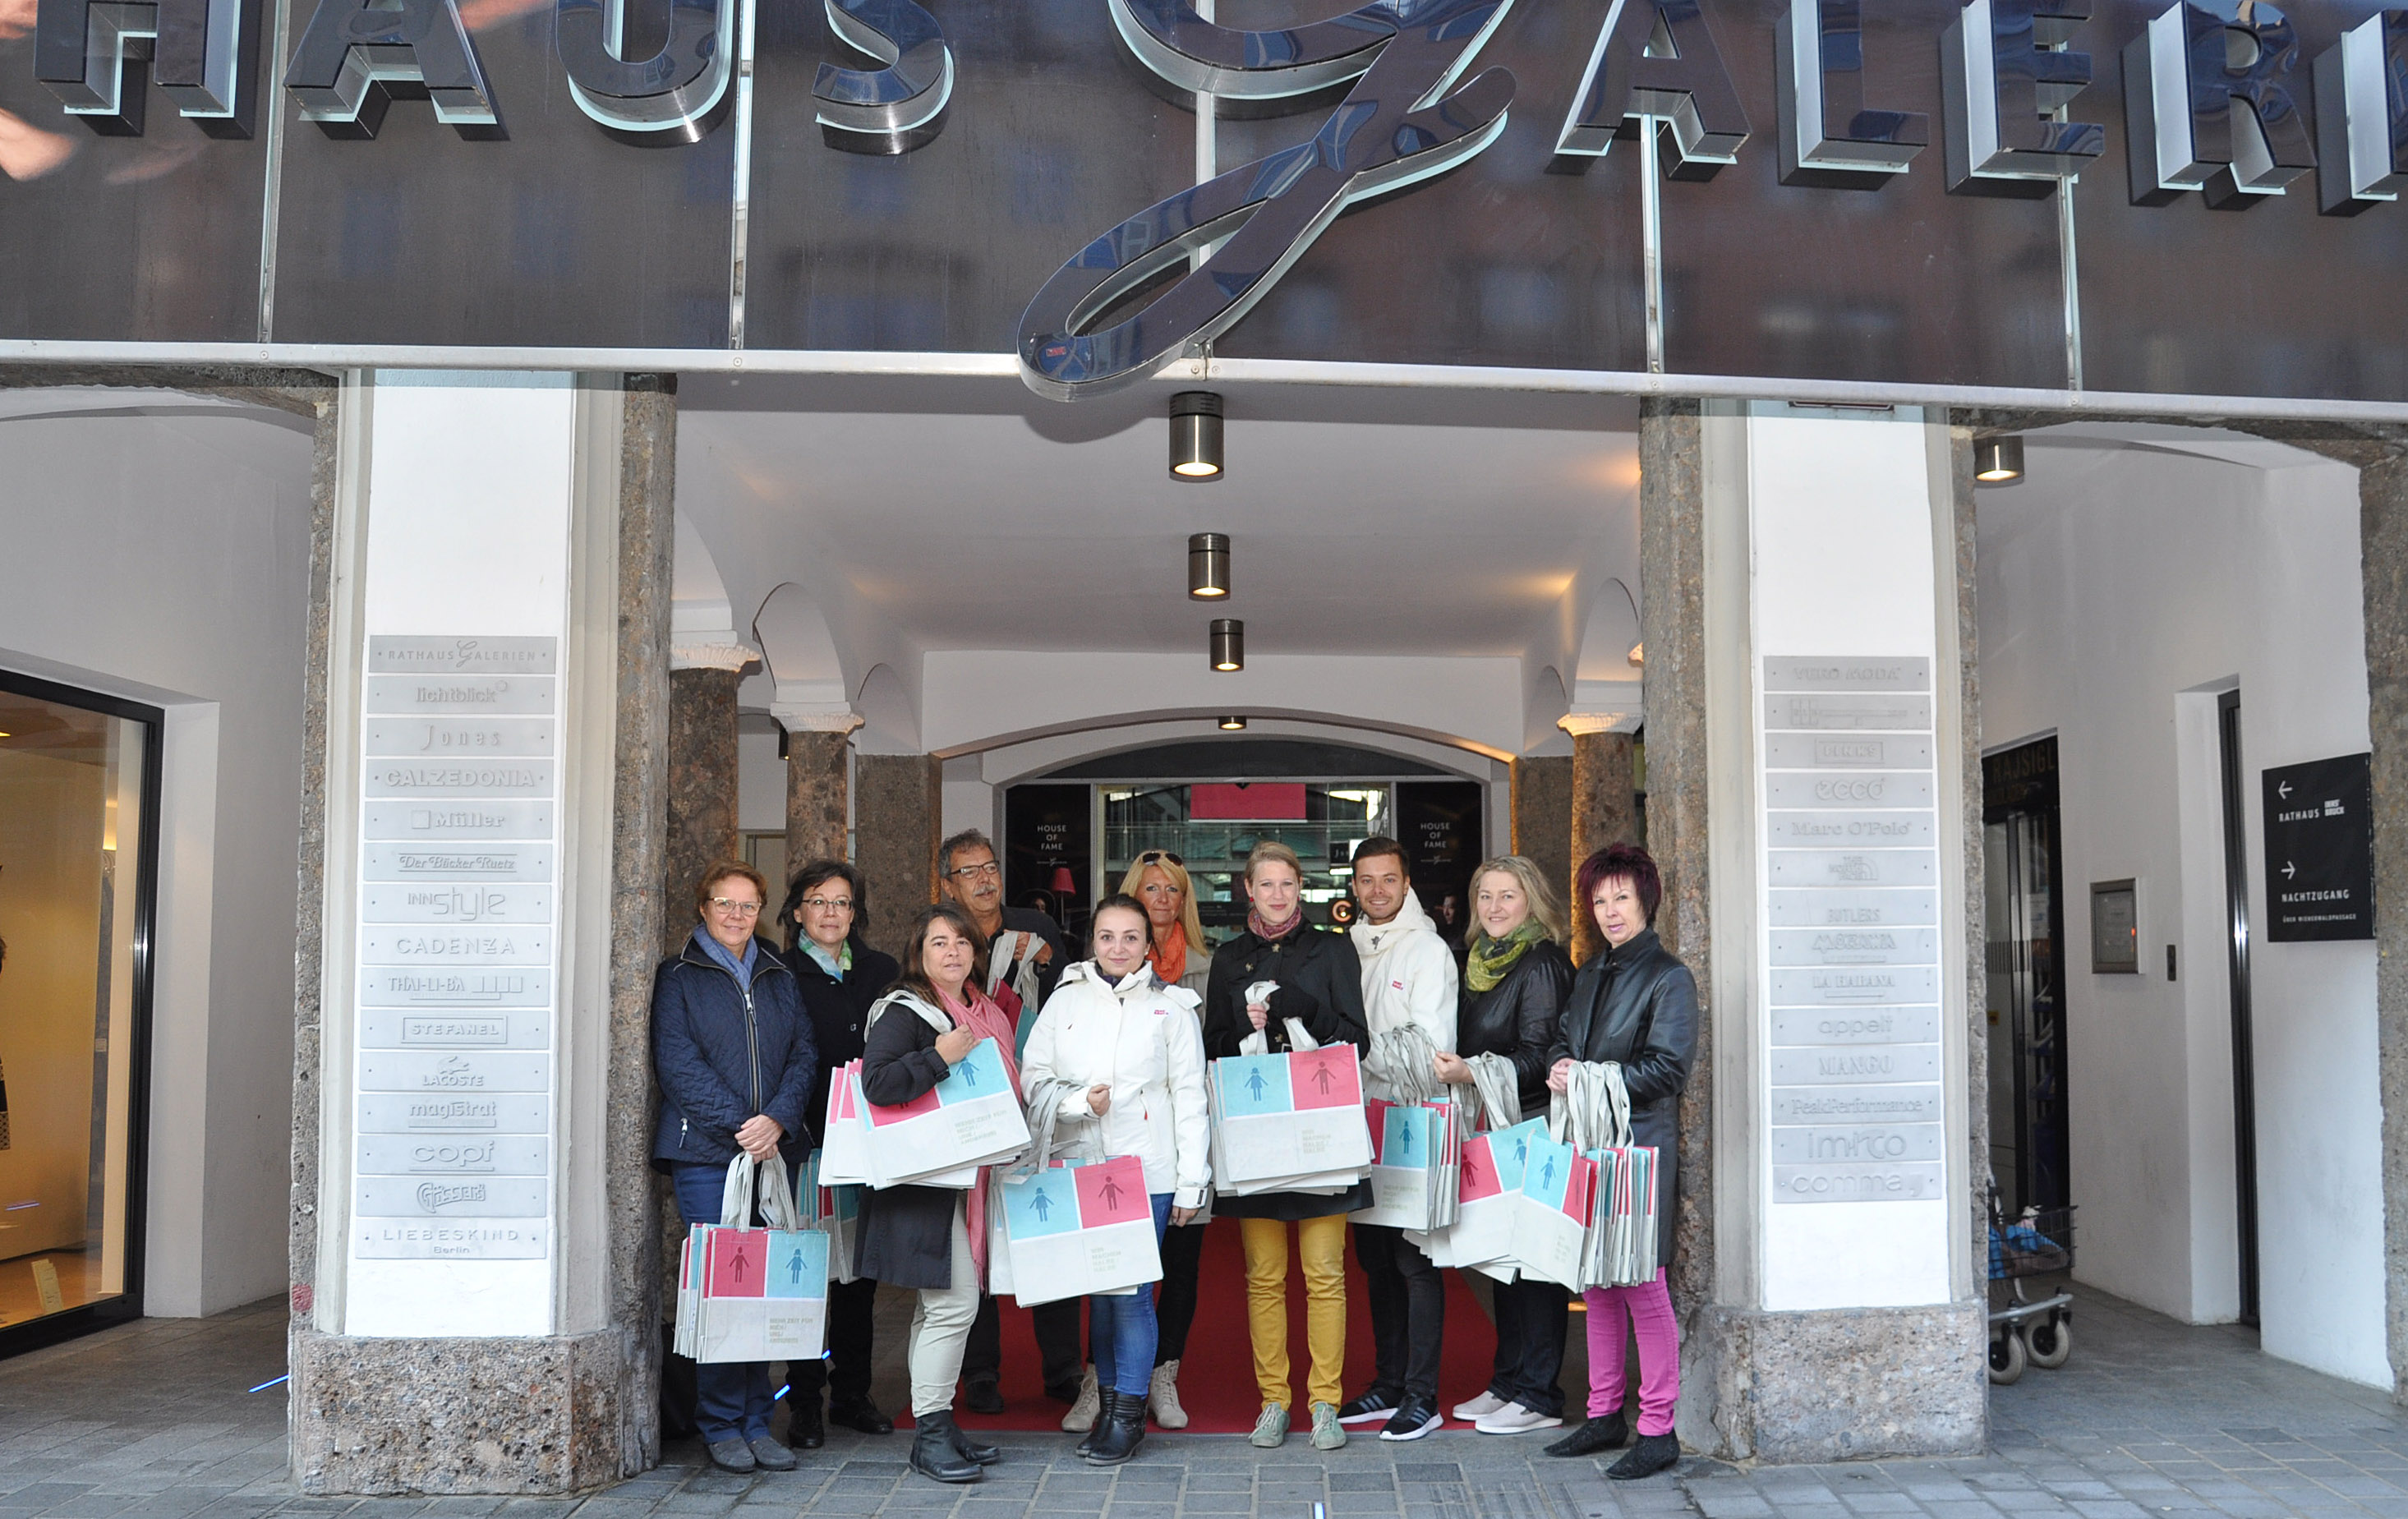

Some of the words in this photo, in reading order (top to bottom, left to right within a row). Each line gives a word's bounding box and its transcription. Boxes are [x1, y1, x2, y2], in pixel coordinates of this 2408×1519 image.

[415, 687, 496, 703] lichtblick
[421, 725, 500, 751] Jones
[386, 769, 535, 787] CALZEDONIA
[1815, 779, 1885, 801] ecco
[435, 812, 505, 828] Müller
[2279, 808, 2320, 822] RATHAUS
[1037, 824, 1067, 833] HOUSE
[1420, 822, 1451, 831] HOUSE
[1792, 822, 1843, 835] Marc
[1046, 834, 1057, 842] OF
[1430, 831, 1440, 840] OF
[1424, 840, 1447, 849] FAME
[399, 856, 426, 869] Der
[428, 856, 475, 869] Bäcker
[476, 856, 515, 870] Ruetz
[2281, 889, 2350, 903] NACHTZUGANG
[397, 937, 516, 955] CADENZA
[411, 1024, 500, 1036] STEFANEL
[1818, 1056, 1894, 1075] MANGO
[421, 1075, 485, 1086] LACOSTE
[409, 1102, 497, 1119] magistrat
[383, 1229, 519, 1241] LIEBESKIND
[434, 1245, 470, 1254] Berlin
